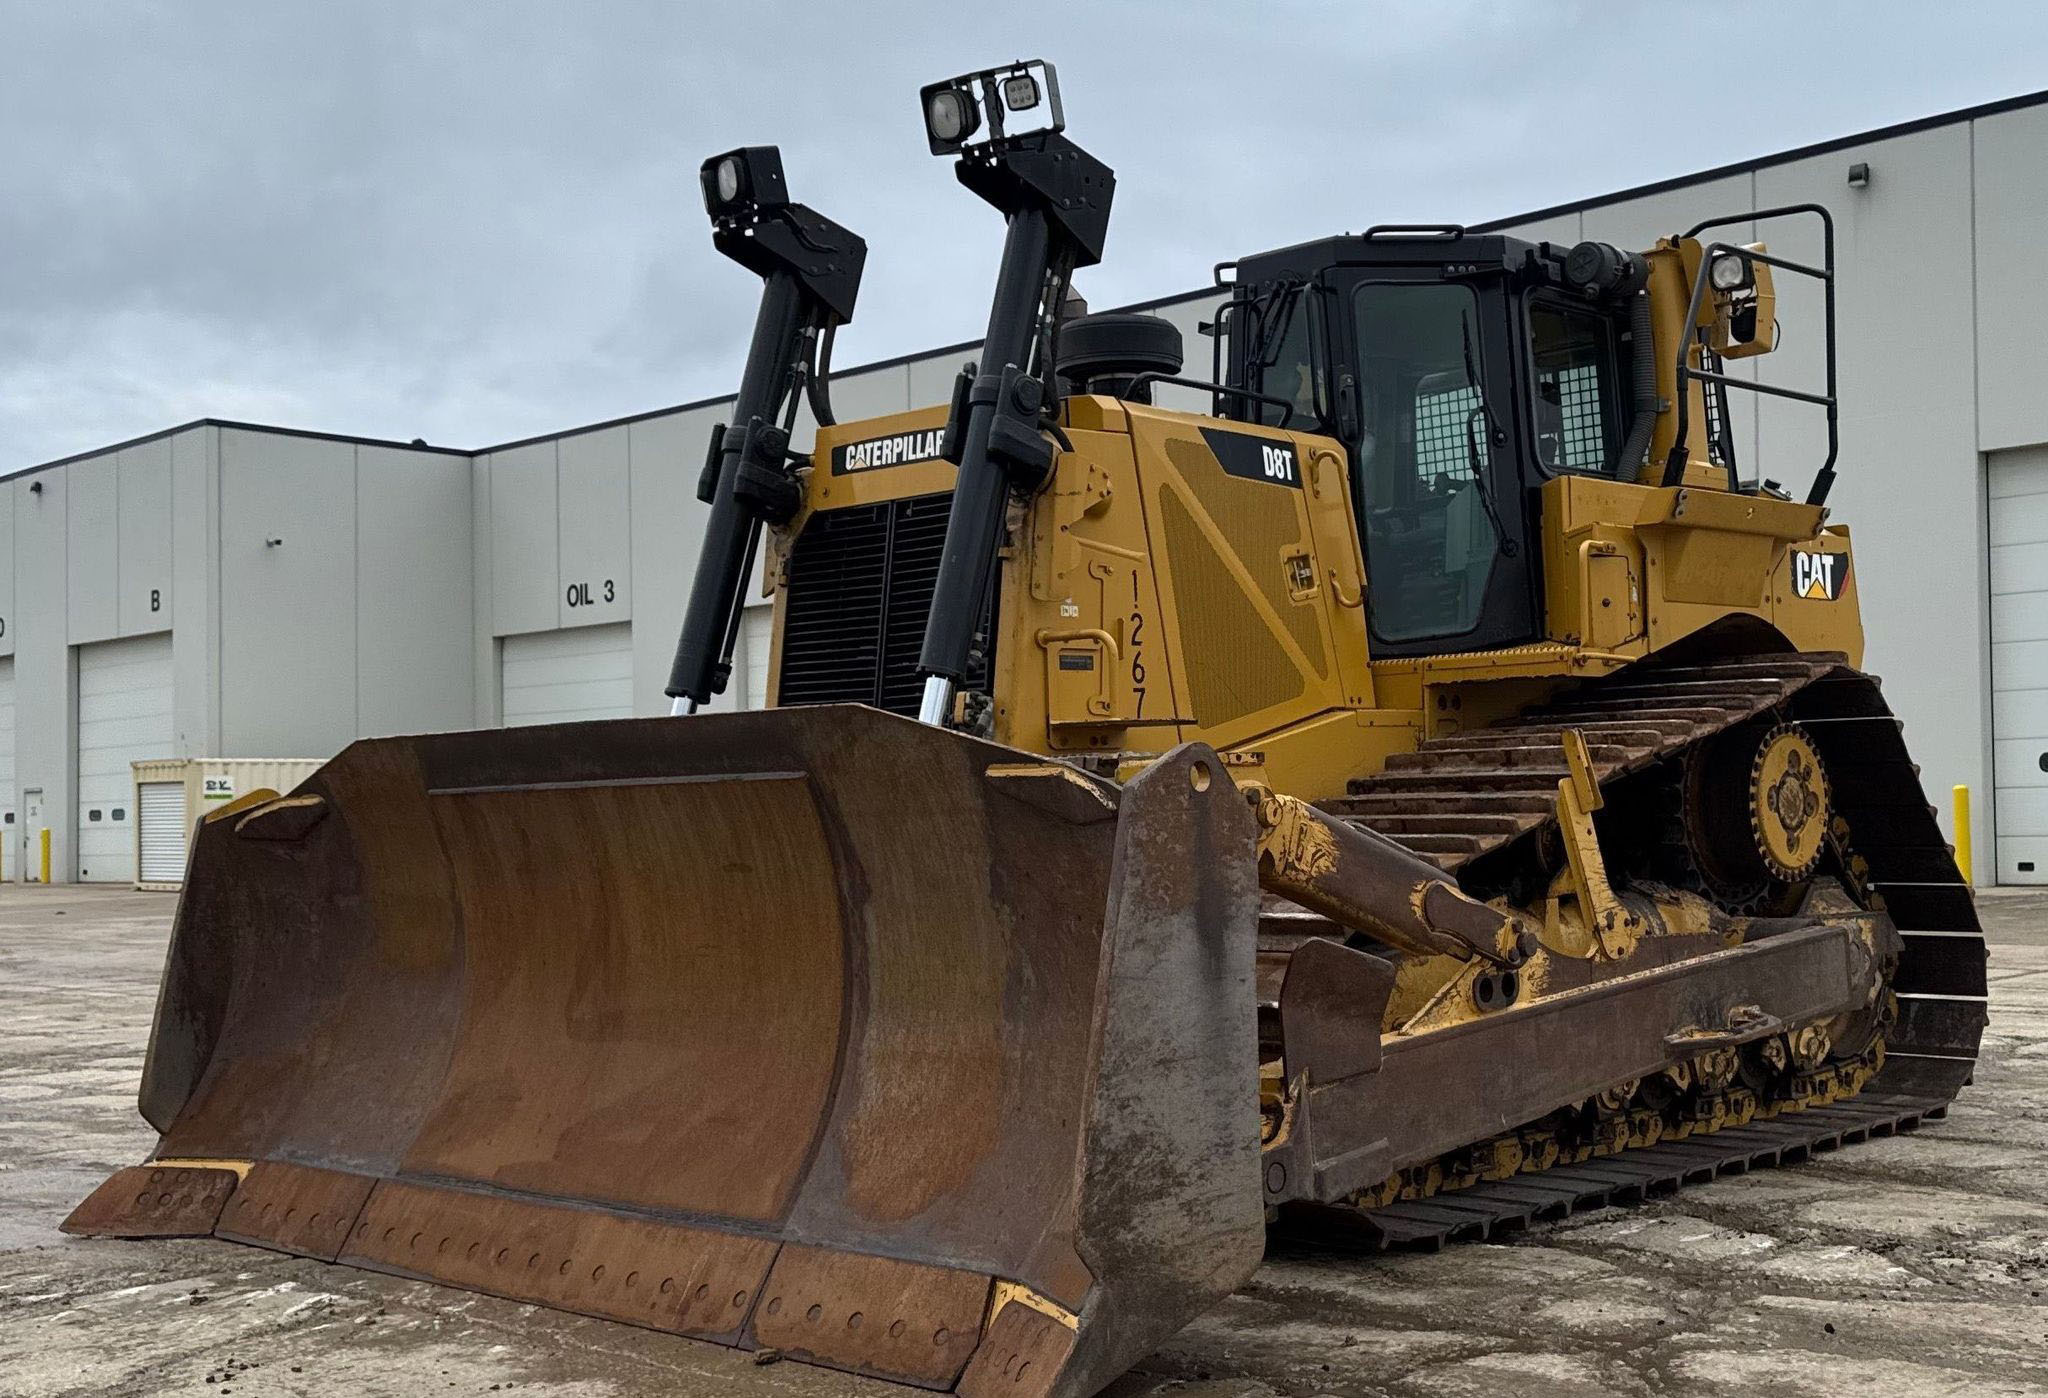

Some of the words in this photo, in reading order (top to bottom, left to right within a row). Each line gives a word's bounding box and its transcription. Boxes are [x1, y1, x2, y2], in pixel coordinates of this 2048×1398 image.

[1262, 445, 1292, 481] D8T
[1796, 552, 1834, 600] CAT
[151, 590, 160, 612] B
[567, 584, 594, 607] OIL
[604, 580, 614, 603] 3
